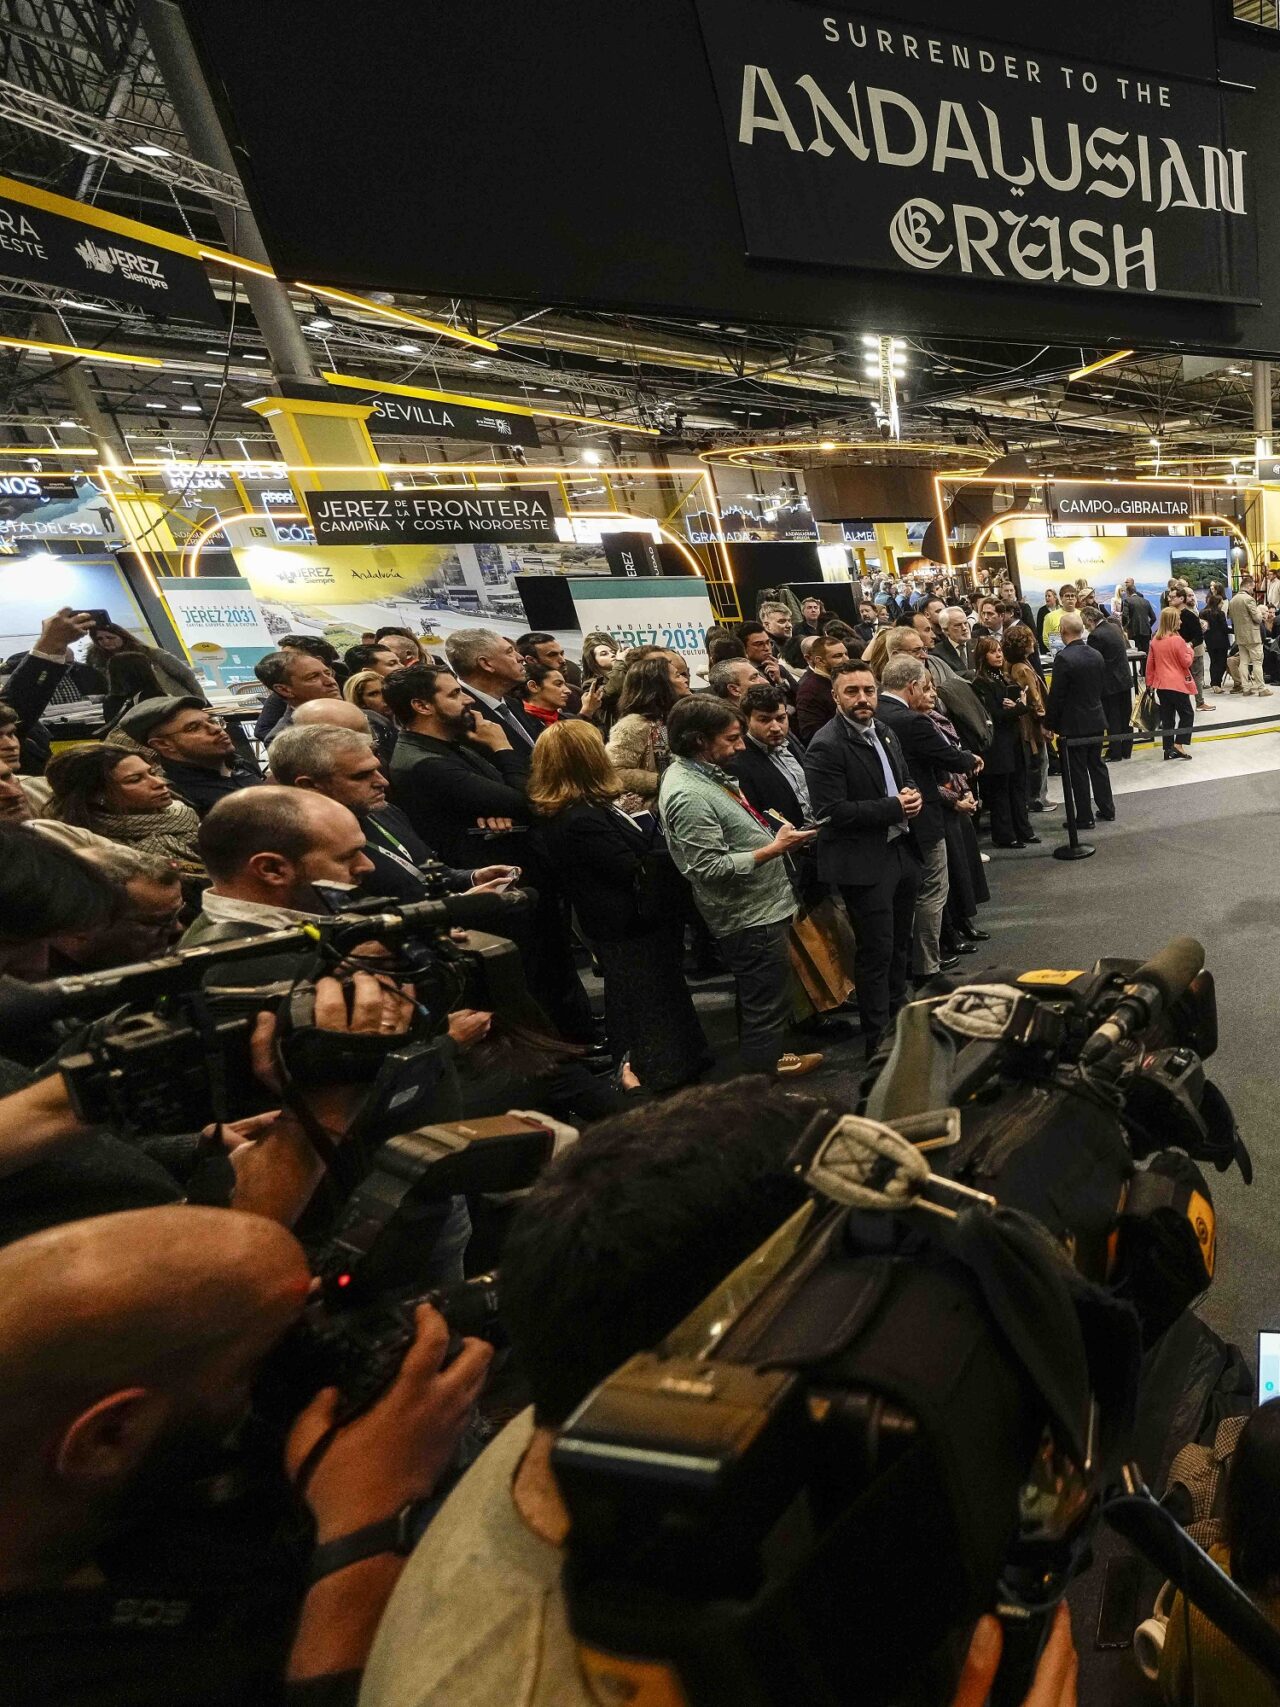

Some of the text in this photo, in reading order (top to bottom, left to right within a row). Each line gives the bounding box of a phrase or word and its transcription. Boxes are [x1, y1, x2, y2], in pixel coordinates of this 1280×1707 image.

[822, 16, 1173, 109] SURRENDER TO THE
[737, 63, 1248, 216] ANDALUSIAN
[888, 197, 1157, 292] CRUSH
[109, 246, 165, 279] JEREZ
[121, 267, 169, 290] Siempre
[372, 400, 456, 428] SEVILLA
[317, 499, 548, 519] JEREZ DE LA FRONTERA
[1058, 499, 1114, 514] CAMPO
[1120, 500, 1189, 515] GIBRALTAR
[68, 521, 103, 535] SOL
[320, 517, 551, 533] CAMPIÑA Y COSTA NOROESTE
[350, 567, 406, 581] Andalucía
[620, 551, 638, 577] EREZ
[180, 609, 258, 624] JEREZ 2031
[594, 621, 704, 632] CANDIDATURA
[662, 628, 708, 651] 2031
